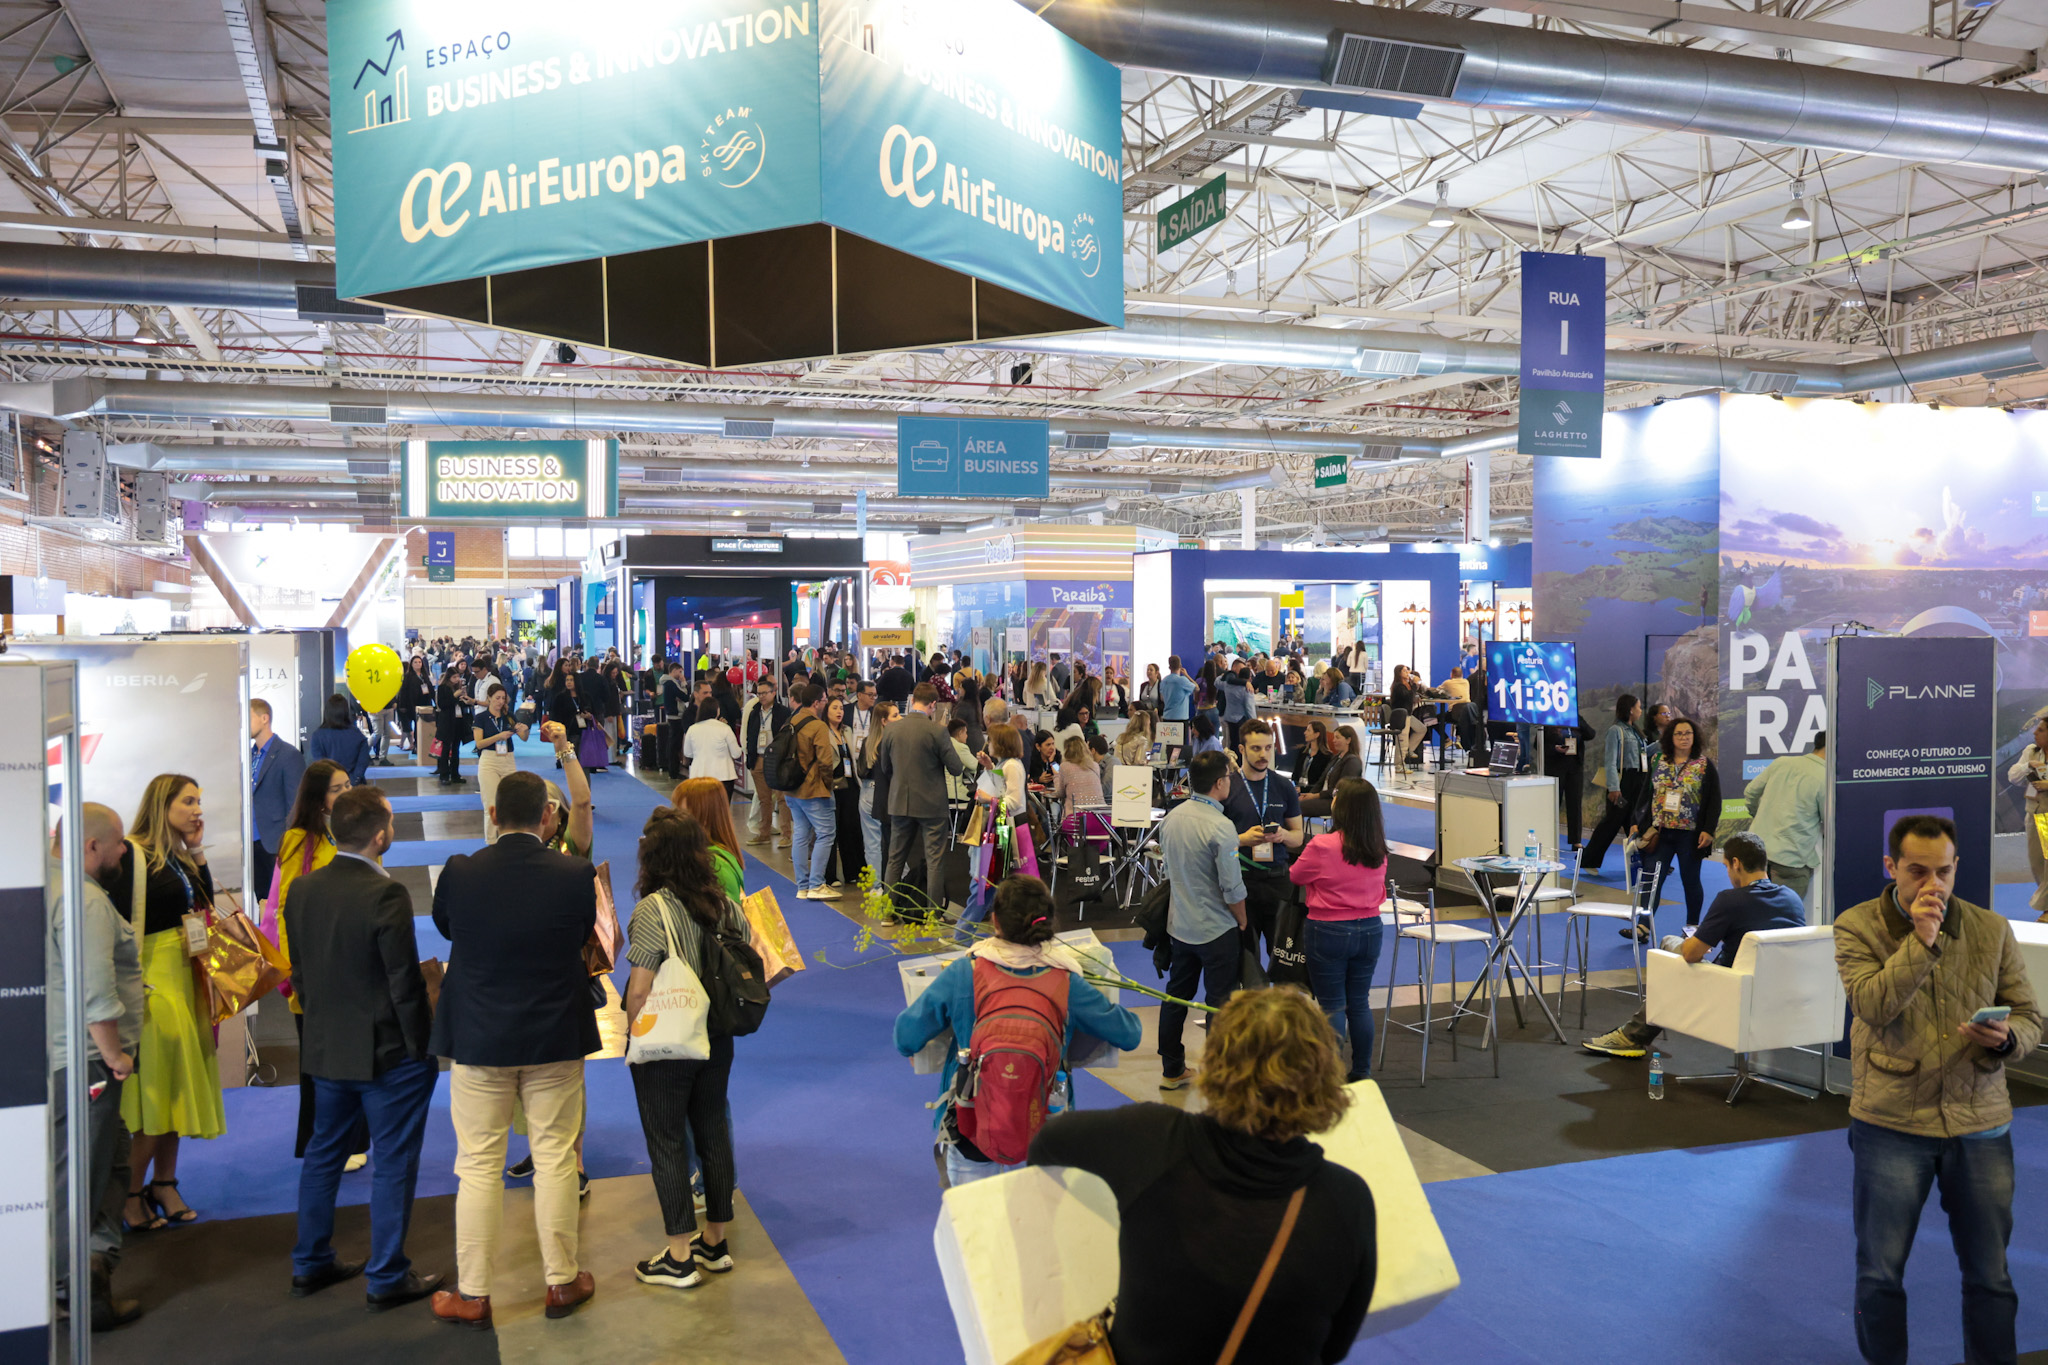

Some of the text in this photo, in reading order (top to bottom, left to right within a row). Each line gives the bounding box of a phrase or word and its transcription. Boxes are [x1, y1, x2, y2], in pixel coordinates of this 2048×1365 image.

[426, 31, 512, 69] ESPAÇO
[427, 5, 810, 117] BUSINESS & INNOVATION
[701, 106, 752, 177] SKYTEAM
[1000, 96, 1015, 131] &
[1017, 104, 1119, 184] INNOVATION
[478, 145, 686, 217] AirEuropa
[941, 163, 1065, 255] AirEuropa
[1168, 197, 1217, 242] SAÍDA
[1071, 211, 1094, 259] SKYTEAM
[1549, 291, 1580, 306] RUA
[1532, 368, 1594, 379] Pavilhão Araucária
[1534, 430, 1588, 440] LAGHETTO
[964, 436, 1007, 454] ÁREA
[438, 457, 560, 476] BUSINESS &
[964, 459, 1039, 474] BUSINESS
[1320, 463, 1342, 478] SAÍDA
[438, 481, 575, 500] INNOVATION
[437, 548, 447, 557] J
[1517, 656, 1543, 665] Festuris
[1729, 631, 1817, 690] PA
[107, 674, 179, 688] IBERIA
[365, 668, 381, 685] 72
[1494, 678, 1570, 713] 11:36
[1889, 684, 1976, 699] PLANNE
[1746, 695, 1827, 754] RA
[1866, 747, 1972, 760] CONHEÇA O FUTURO DO
[1853, 764, 1985, 778] ECOMMERCE PARA O TURISMO
